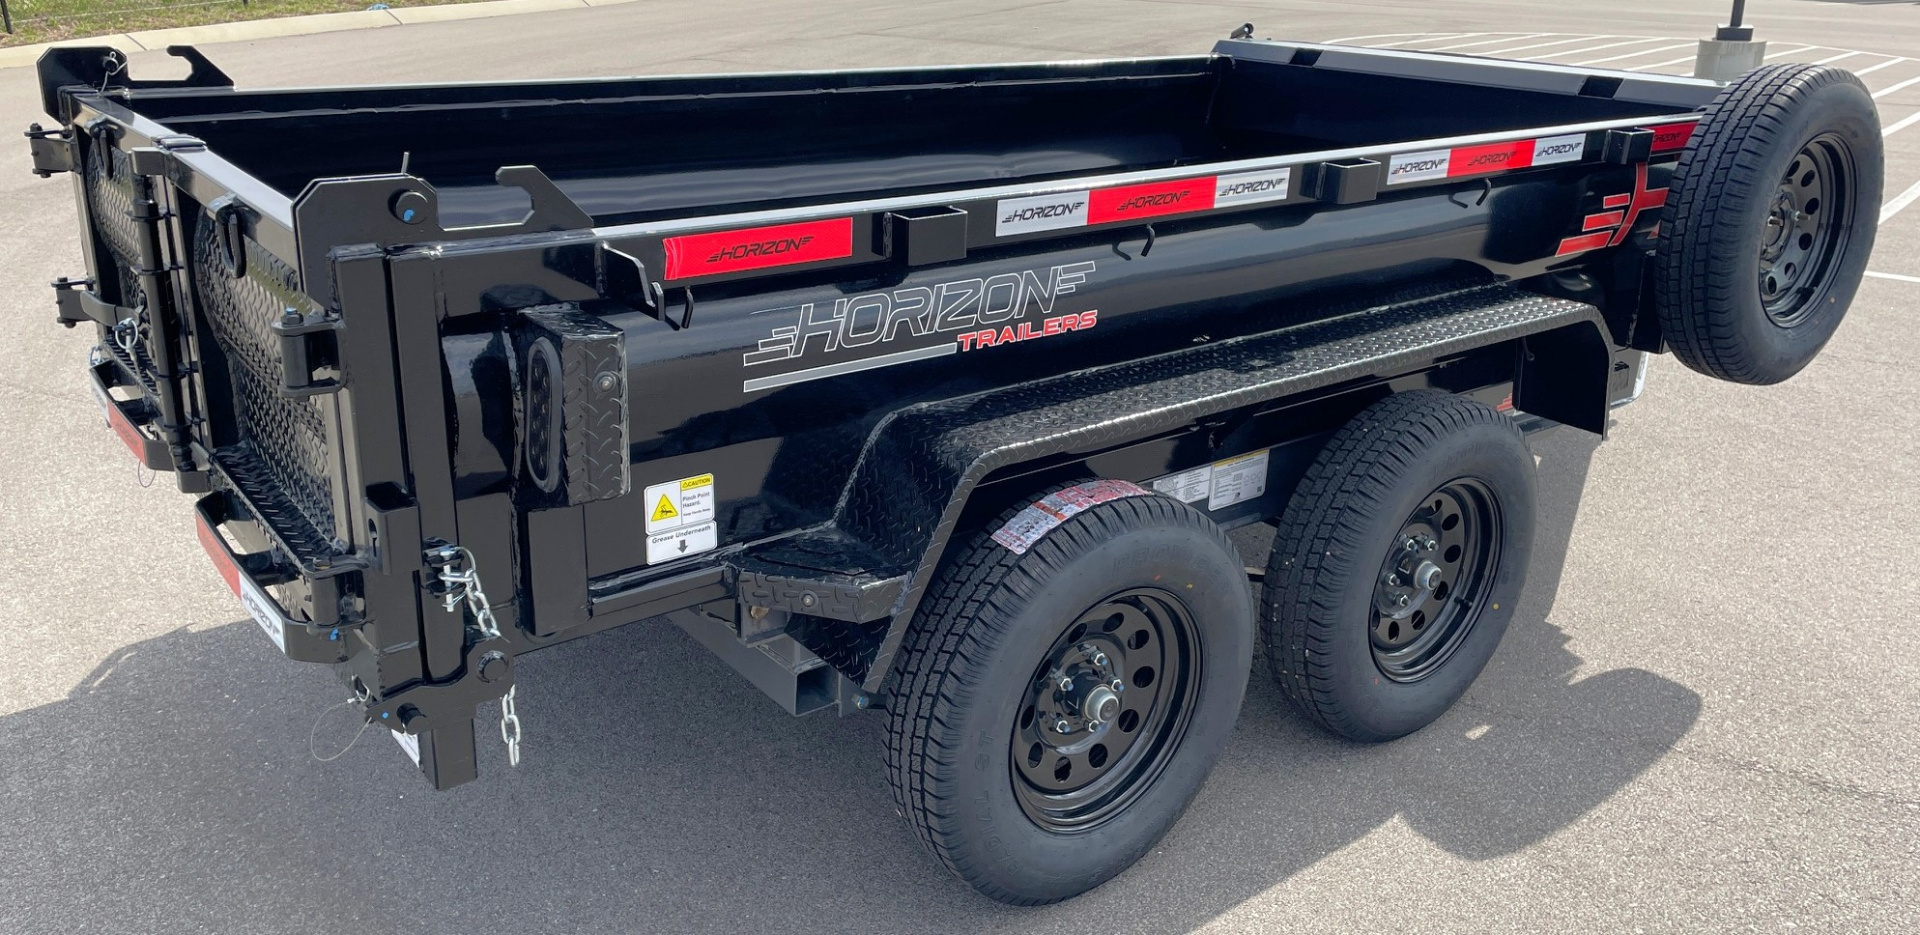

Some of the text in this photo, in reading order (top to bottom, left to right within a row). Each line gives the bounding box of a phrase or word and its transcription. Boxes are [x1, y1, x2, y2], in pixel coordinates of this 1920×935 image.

[1467, 151, 1516, 166] HORIZON
[1536, 142, 1582, 157] HORIZON
[1391, 158, 1447, 175] HORIZON
[1219, 177, 1285, 197] HORIZON
[1117, 190, 1190, 211] HORIZON
[1001, 201, 1084, 224] HORIZON
[706, 236, 814, 263] HORIZON
[744, 261, 1095, 366] HORIZON
[957, 310, 1098, 352] TRAILERS
[687, 477, 711, 487] CAUTION
[682, 494, 697, 502] Pinch
[652, 525, 711, 544] Grease Underneath
